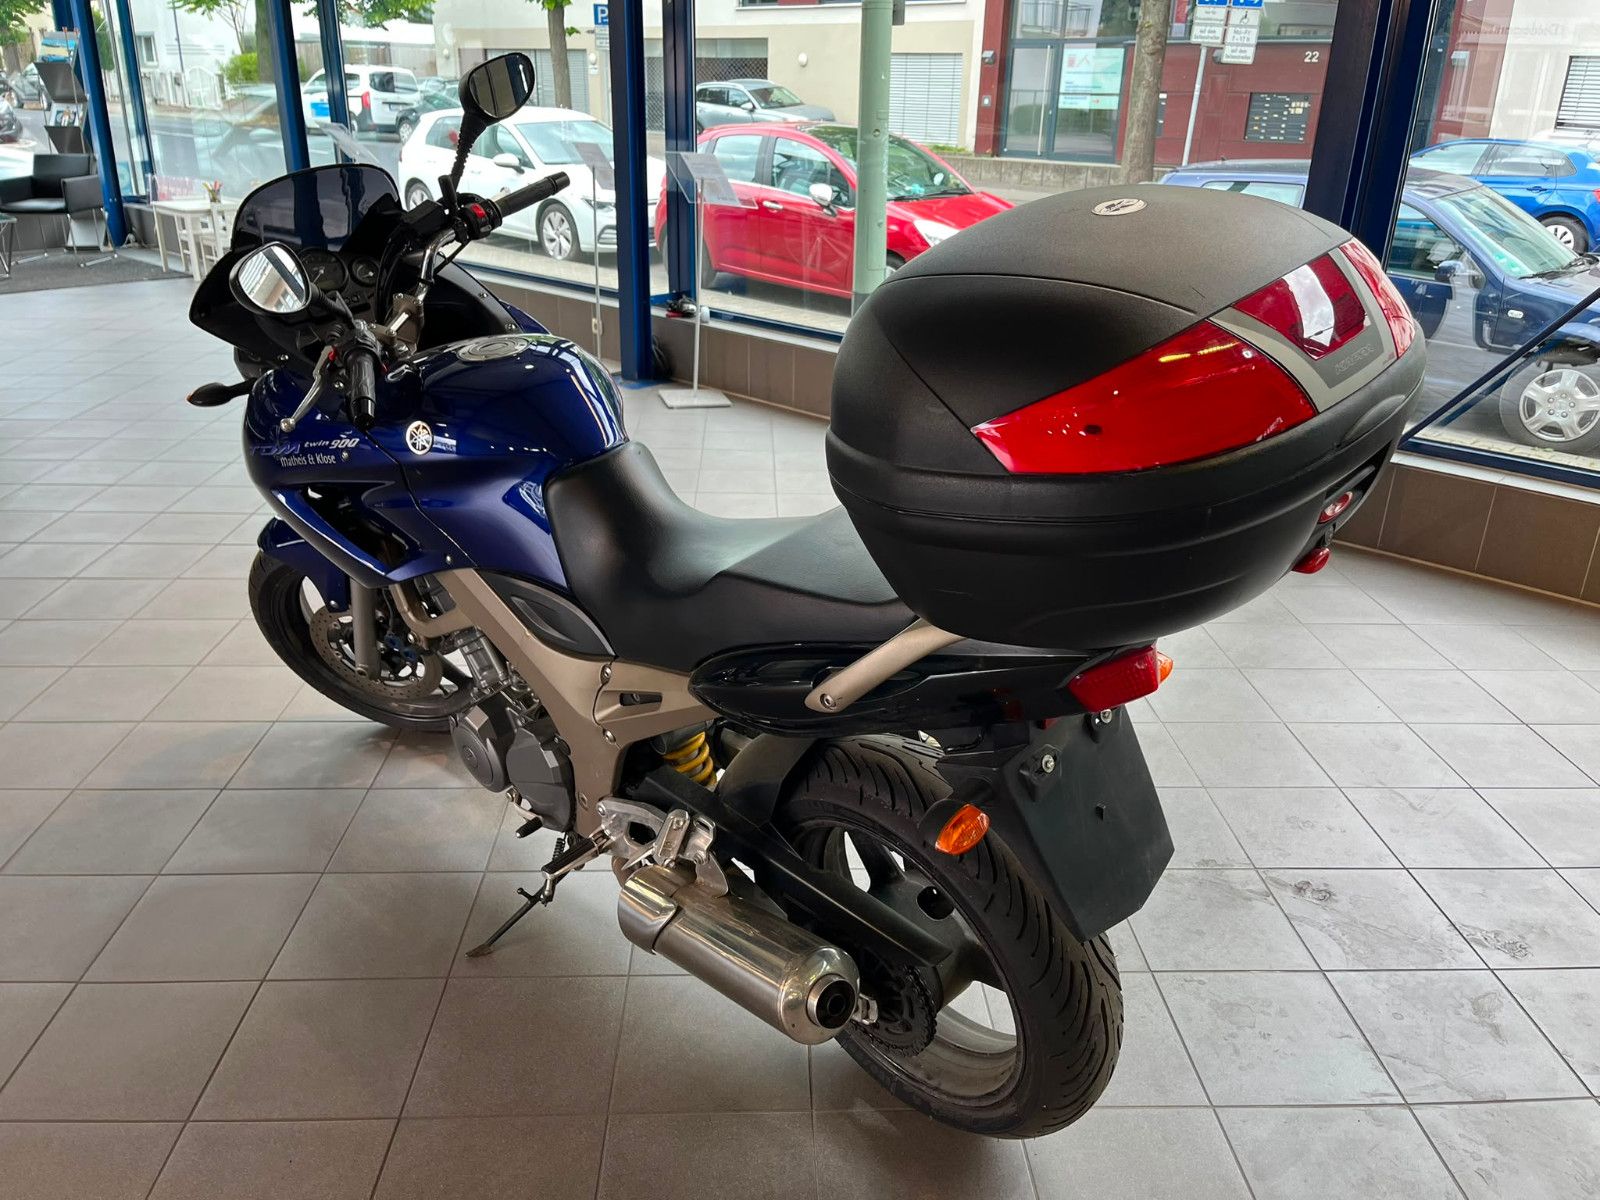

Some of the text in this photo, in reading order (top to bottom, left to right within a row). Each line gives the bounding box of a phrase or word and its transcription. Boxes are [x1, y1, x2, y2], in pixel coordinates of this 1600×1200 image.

[1303, 50, 1320, 63] 22
[304, 440, 329, 448] twin
[329, 438, 360, 449] 900
[280, 453, 337, 467] Matheis & Klose
